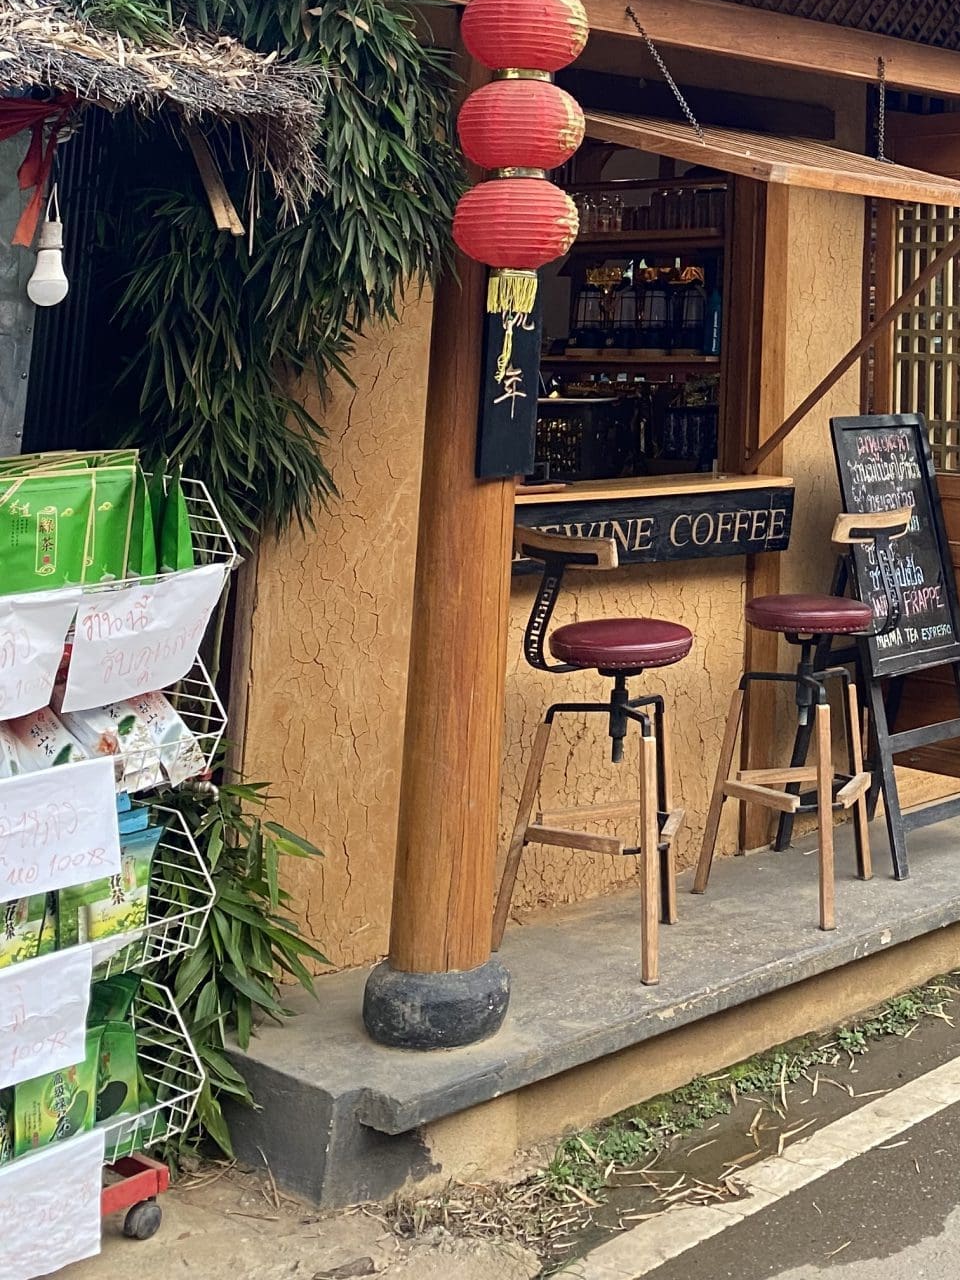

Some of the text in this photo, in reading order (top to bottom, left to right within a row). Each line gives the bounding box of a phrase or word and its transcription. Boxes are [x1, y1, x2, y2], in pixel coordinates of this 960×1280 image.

[669, 507, 786, 548] COFFEE
[903, 585, 945, 618] FRAPPE
[876, 624, 952, 649] MAMA TEA ESPRESSO
